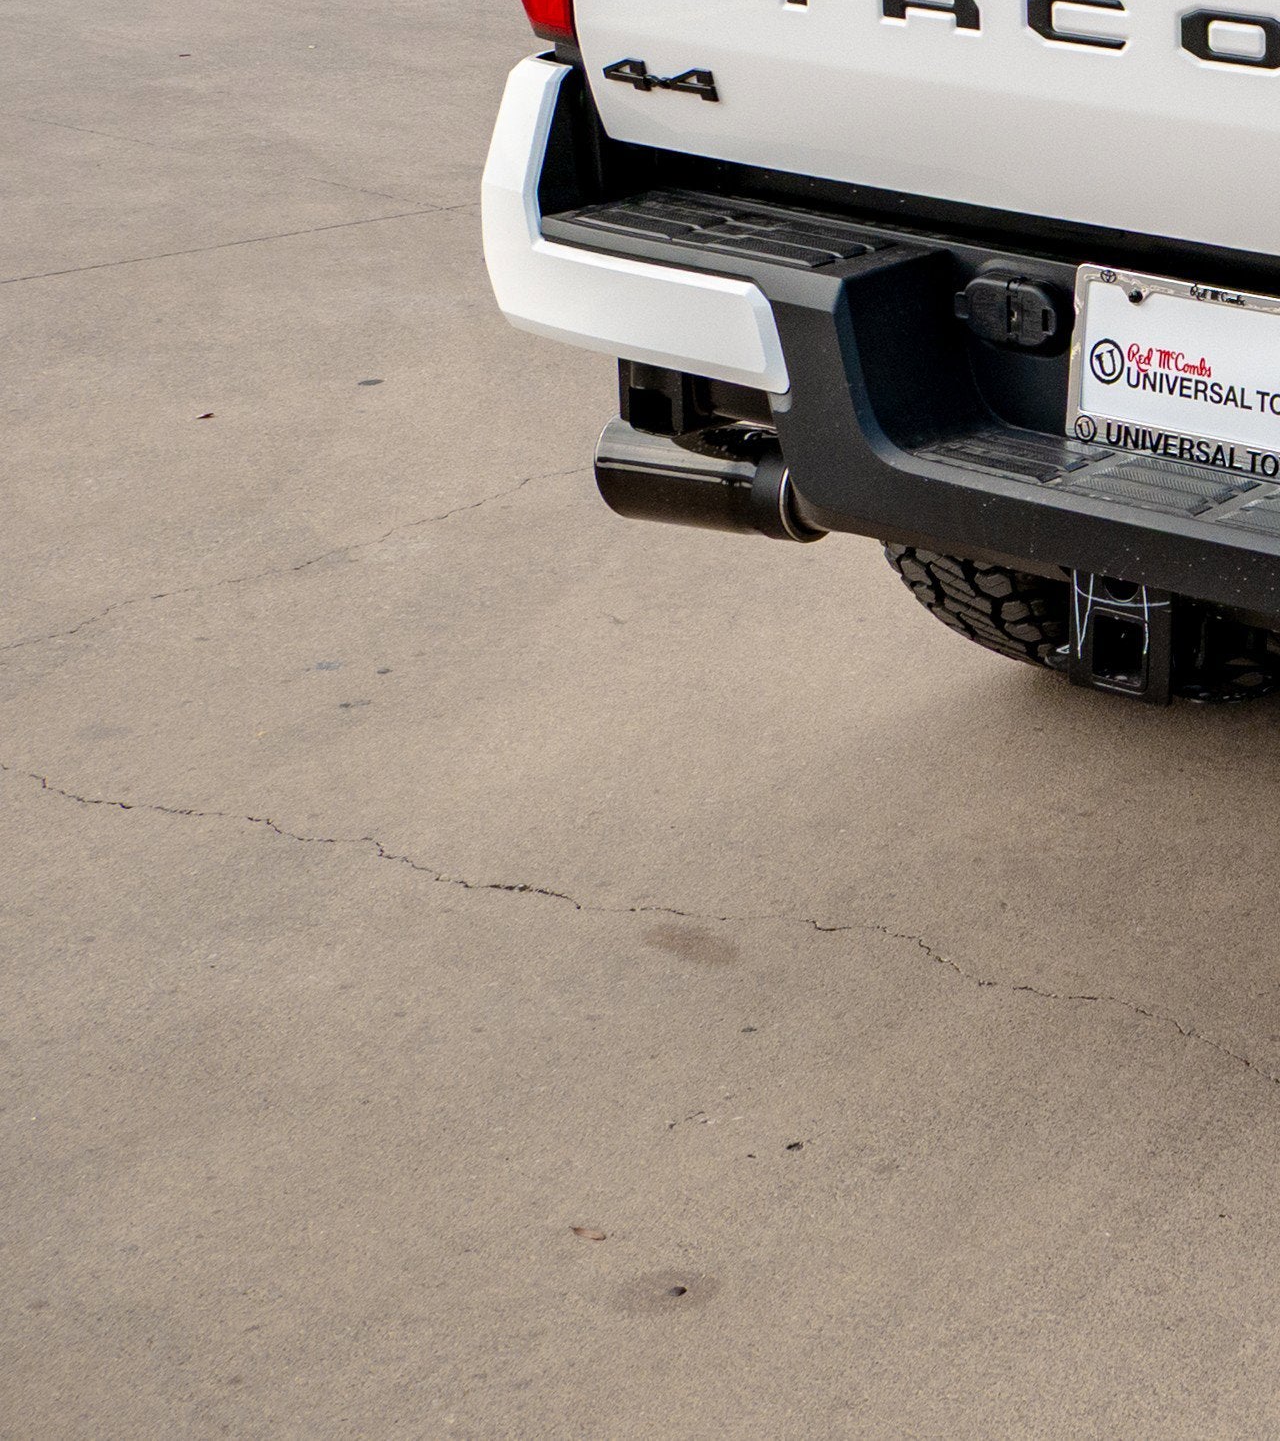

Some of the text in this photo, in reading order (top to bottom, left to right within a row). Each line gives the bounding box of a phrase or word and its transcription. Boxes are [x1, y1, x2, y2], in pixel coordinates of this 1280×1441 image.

[1127, 342, 1212, 378] Red McCombs
[1126, 366, 1252, 411] UNIVERSAL
[1105, 420, 1243, 472] UNIVERSAL
